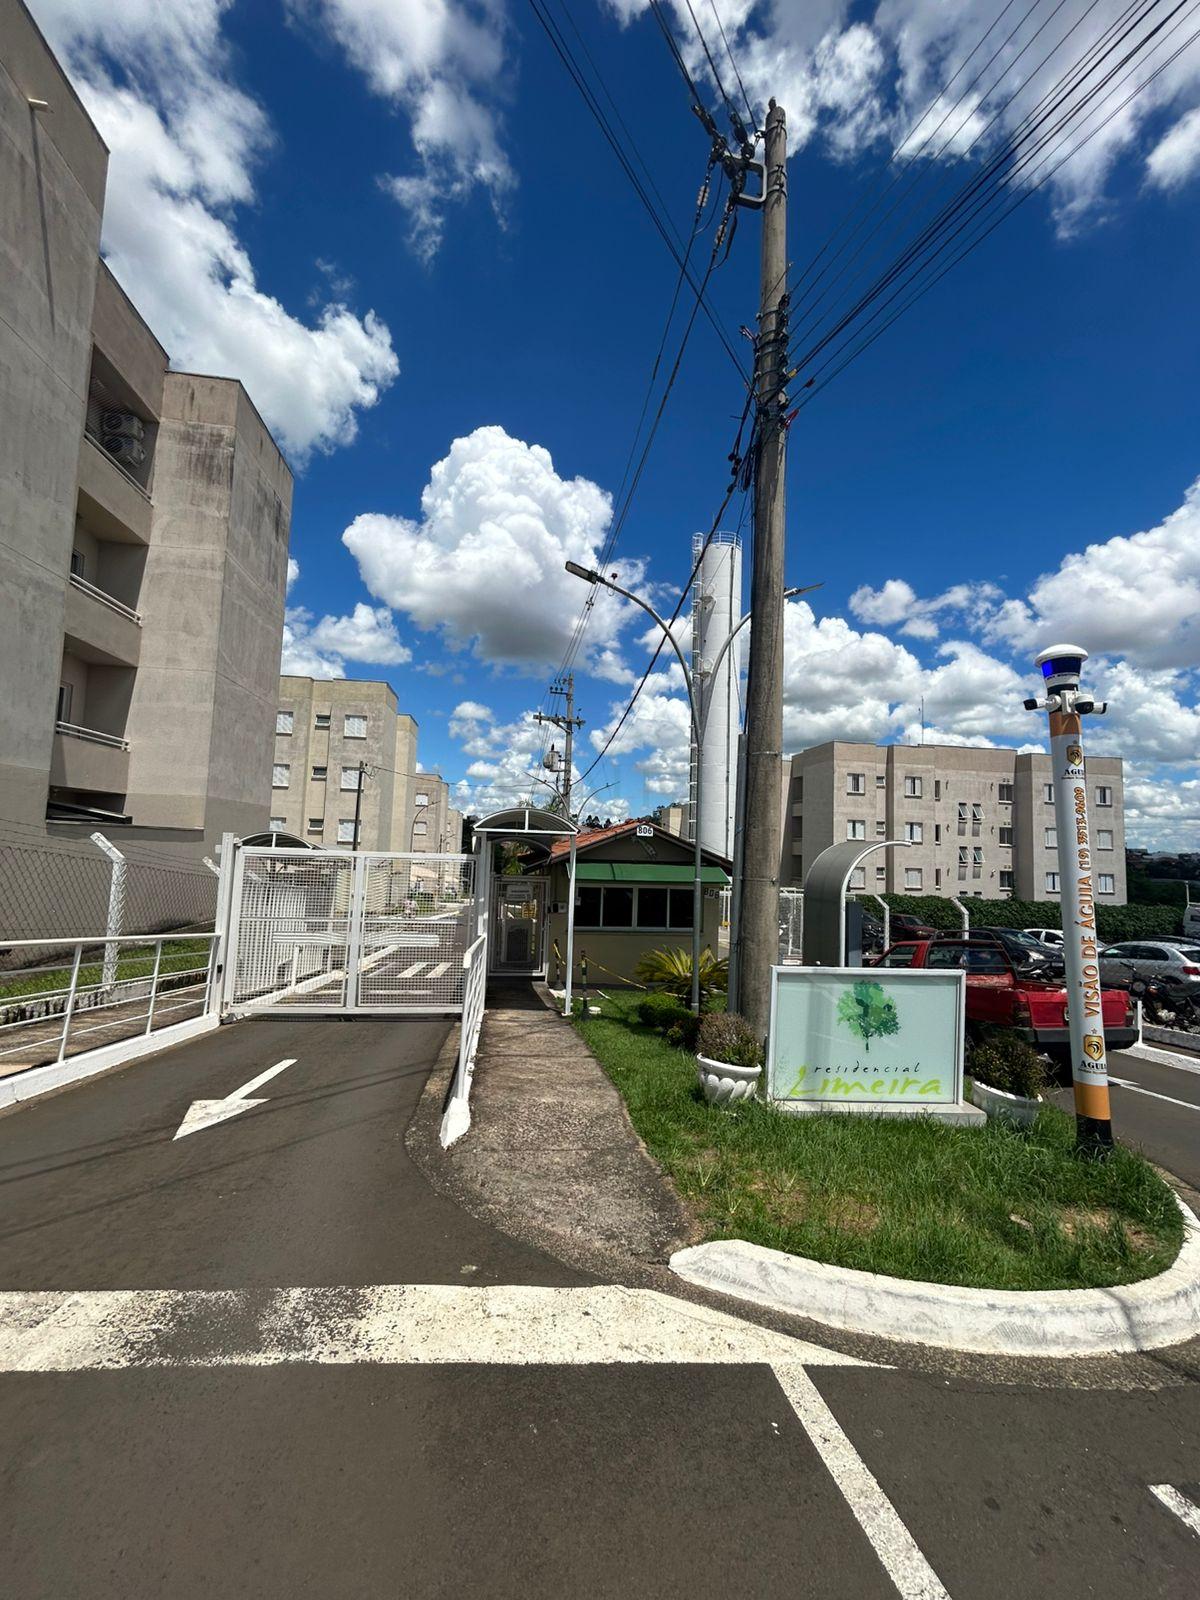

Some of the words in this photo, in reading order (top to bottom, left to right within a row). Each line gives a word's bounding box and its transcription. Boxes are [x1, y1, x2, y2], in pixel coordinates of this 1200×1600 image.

[638, 826, 652, 834] 806
[1078, 848, 1092, 871] (19)
[1075, 876, 1095, 930] ÁGUIA
[1080, 936, 1098, 959] DE
[1079, 966, 1099, 1018] VISÃO
[814, 1061, 920, 1073] residencial
[789, 1065, 943, 1096] Limeira
